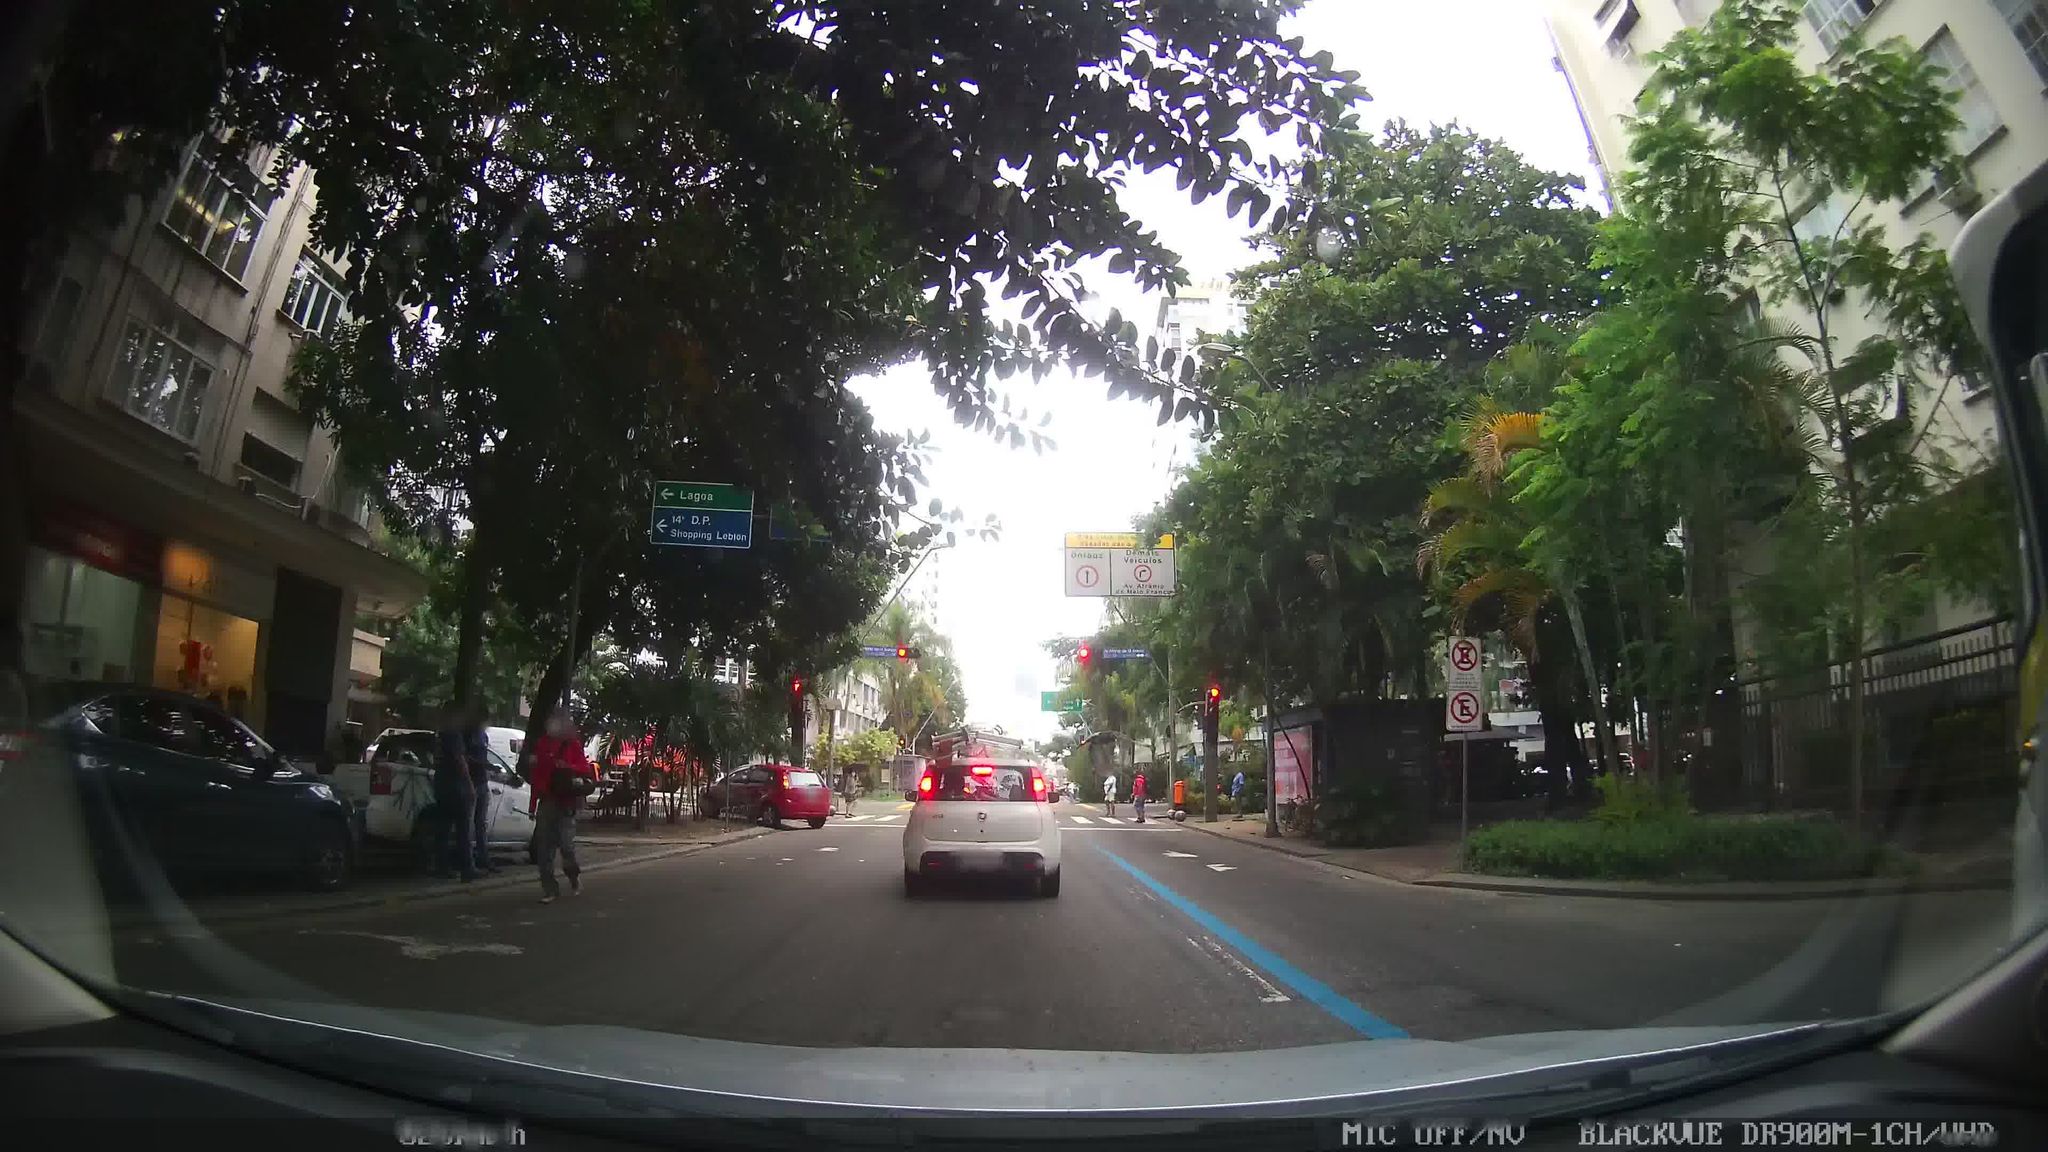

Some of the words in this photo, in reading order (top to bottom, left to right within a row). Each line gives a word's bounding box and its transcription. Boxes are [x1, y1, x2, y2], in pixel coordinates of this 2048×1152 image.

[679, 489, 713, 502] Lagoa
[691, 515, 711, 526] D.P.
[670, 528, 712, 541] Shopping
[716, 530, 747, 542] Leblon
